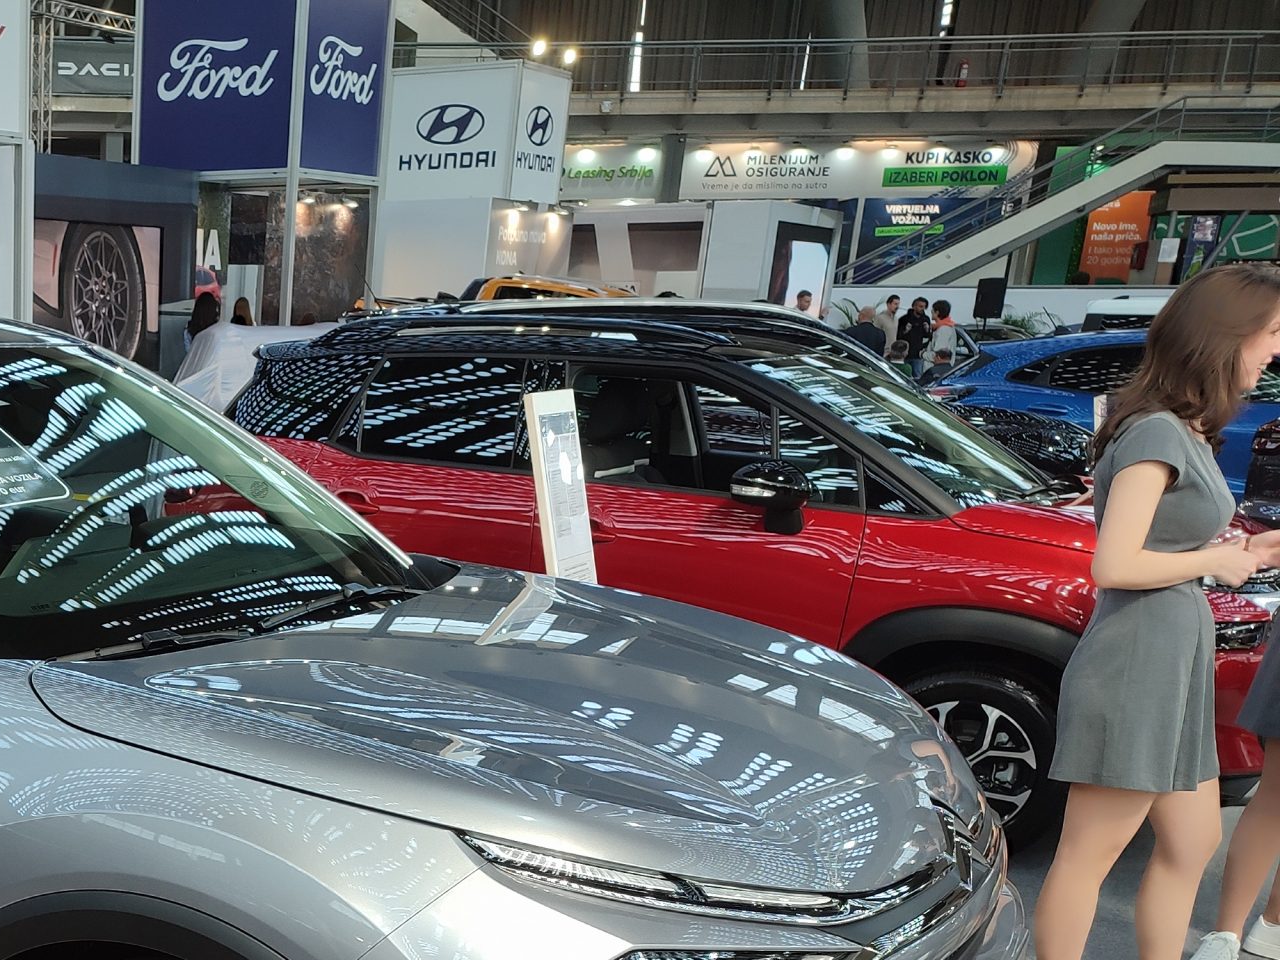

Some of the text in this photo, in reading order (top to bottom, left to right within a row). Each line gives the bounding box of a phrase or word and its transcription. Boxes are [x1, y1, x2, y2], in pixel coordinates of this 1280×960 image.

[57, 62, 135, 76] DACI
[157, 37, 279, 102] Ford
[310, 35, 378, 105] Ford
[398, 150, 497, 171] HYUNDAI
[515, 151, 556, 173] HYUNDAI
[746, 154, 820, 166] MILENIJUM
[905, 151, 993, 165] KUPI KASKO
[567, 167, 615, 182] Leasing
[745, 166, 831, 178] OSIGURANJE
[888, 169, 999, 184] IZABERI POKLON
[701, 182, 729, 190] Vreme
[741, 182, 753, 190] da
[755, 181, 789, 190] mislimo
[791, 182, 803, 190] na
[805, 182, 828, 190] sutra
[885, 204, 940, 215] VIRTUELNA
[891, 213, 931, 225] VOŽNJA
[1092, 222, 1117, 231] Novo
[8, 473, 42, 483] VOZILA
